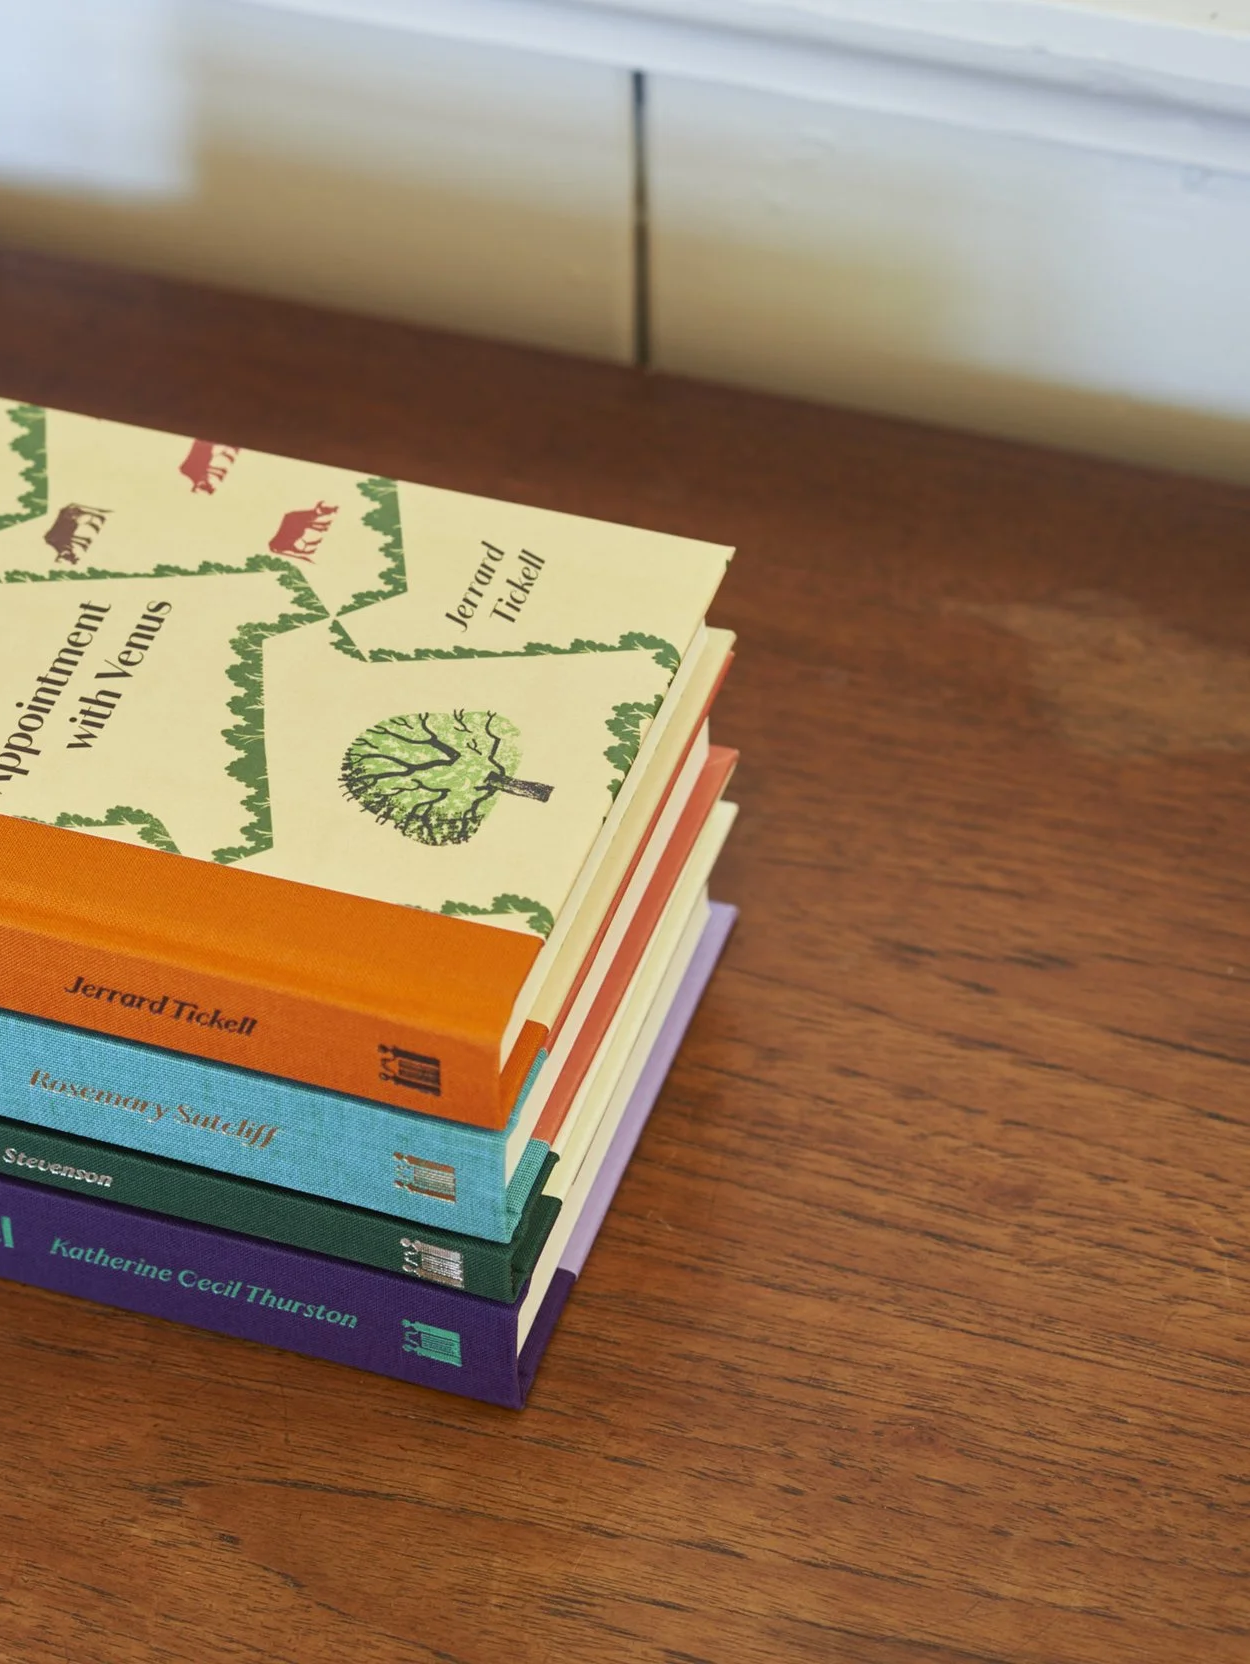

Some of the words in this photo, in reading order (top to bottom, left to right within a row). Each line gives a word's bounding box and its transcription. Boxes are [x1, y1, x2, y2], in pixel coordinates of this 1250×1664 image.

[445, 540, 505, 633] Jerrard
[489, 548, 546, 623] Tickell
[94, 600, 172, 679] Venus
[66, 689, 123, 749] with
[64, 976, 169, 1015] Jerrard
[171, 1001, 258, 1036] Tickell
[29, 1068, 170, 1123] Rosemary
[174, 1103, 280, 1149] Sutcliff
[2, 1148, 113, 1187] Stevenson
[51, 1237, 171, 1282] Katherine
[177, 1268, 242, 1299] Cecil
[246, 1285, 358, 1328] Thurston
